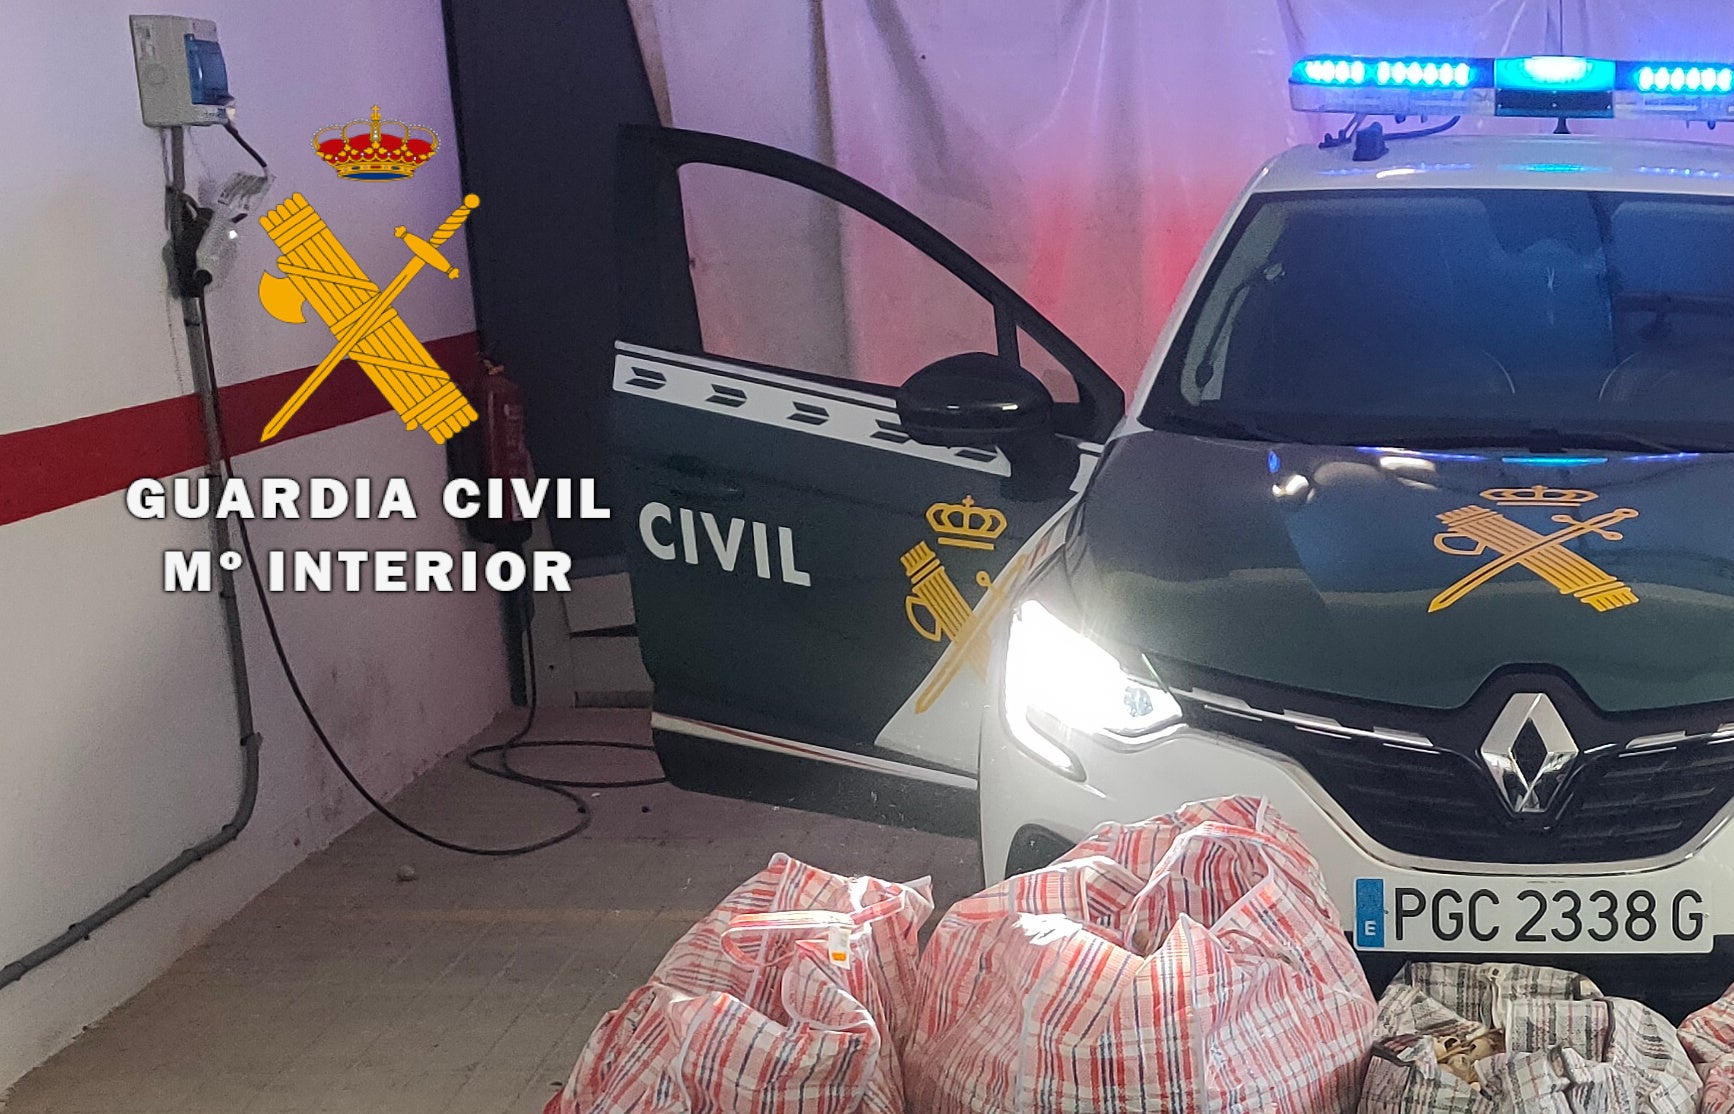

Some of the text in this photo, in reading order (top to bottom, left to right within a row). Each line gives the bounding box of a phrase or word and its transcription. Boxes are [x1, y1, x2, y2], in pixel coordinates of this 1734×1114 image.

[638, 502, 811, 587] CIVIL
[1364, 920, 1377, 936] E
[1395, 887, 1703, 942] PGC 2338 G
